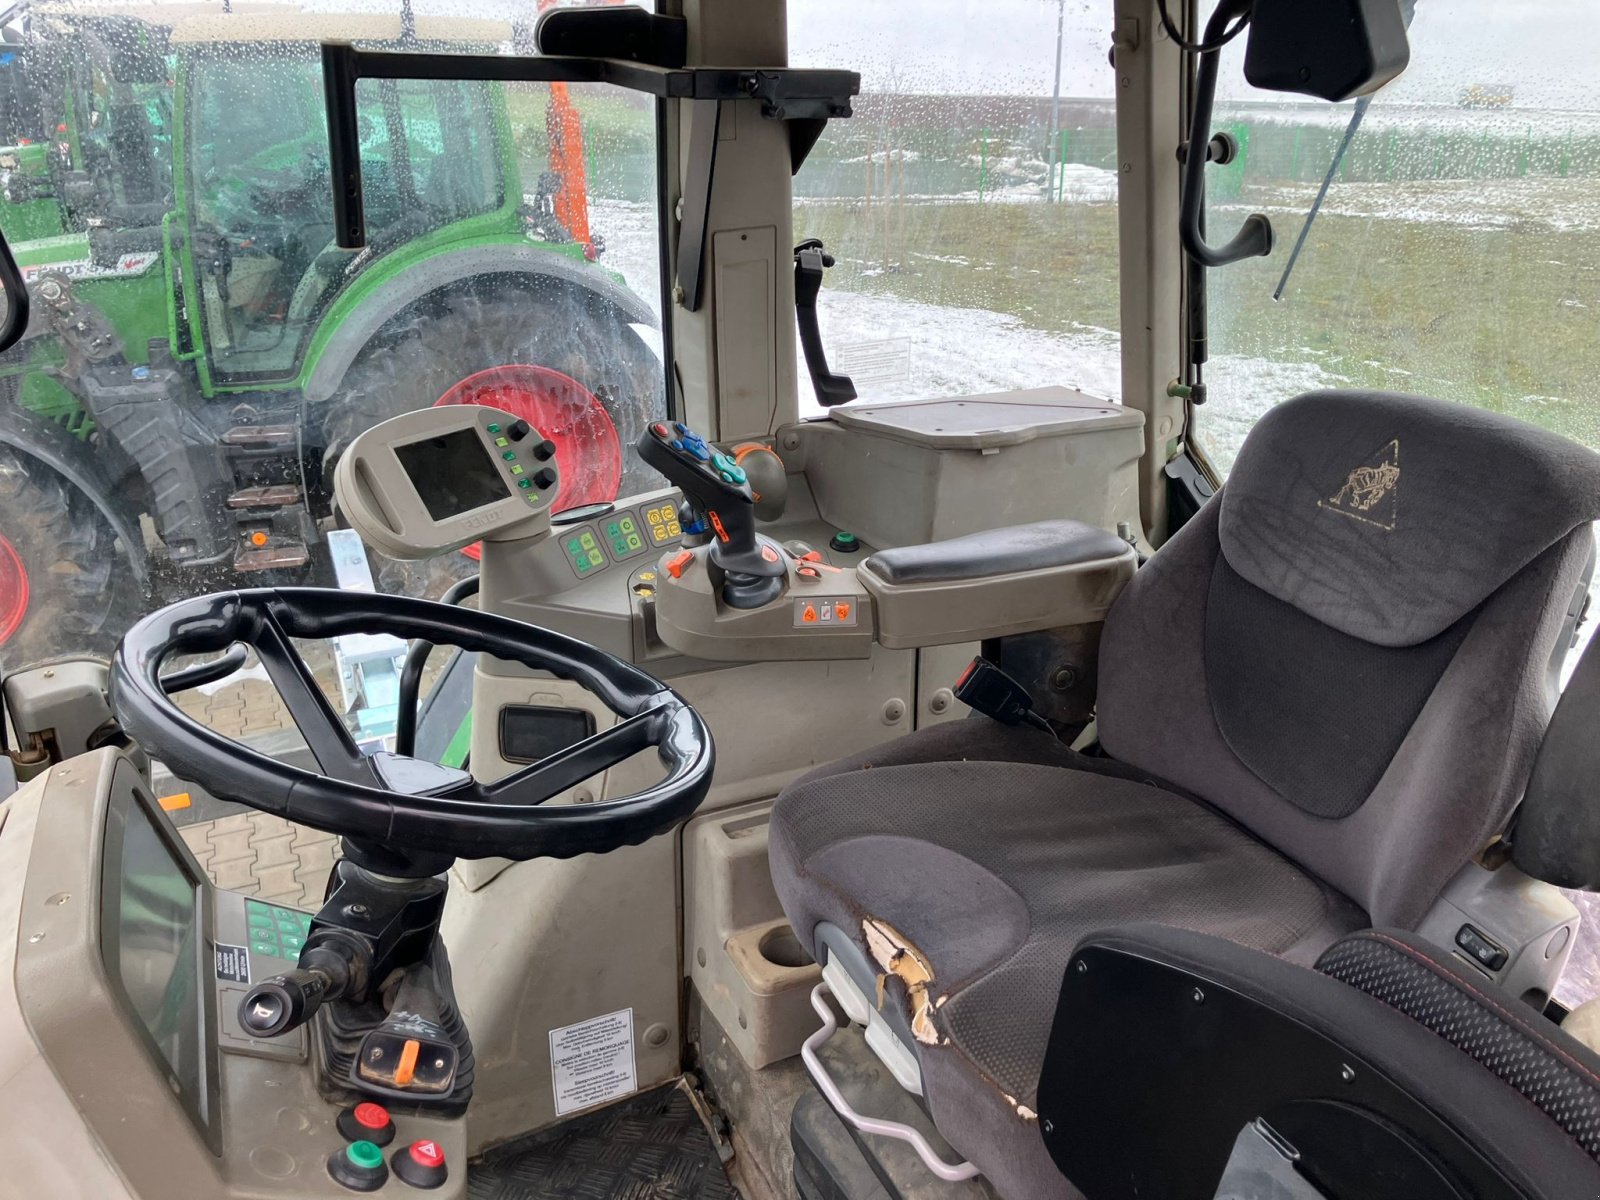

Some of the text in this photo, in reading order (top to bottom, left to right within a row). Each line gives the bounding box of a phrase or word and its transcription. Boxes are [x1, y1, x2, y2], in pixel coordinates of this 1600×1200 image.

[463, 510, 503, 530] FENDT
[555, 1053, 582, 1064] CONSIGNE
[592, 1039, 629, 1053] REMORQUAGE
